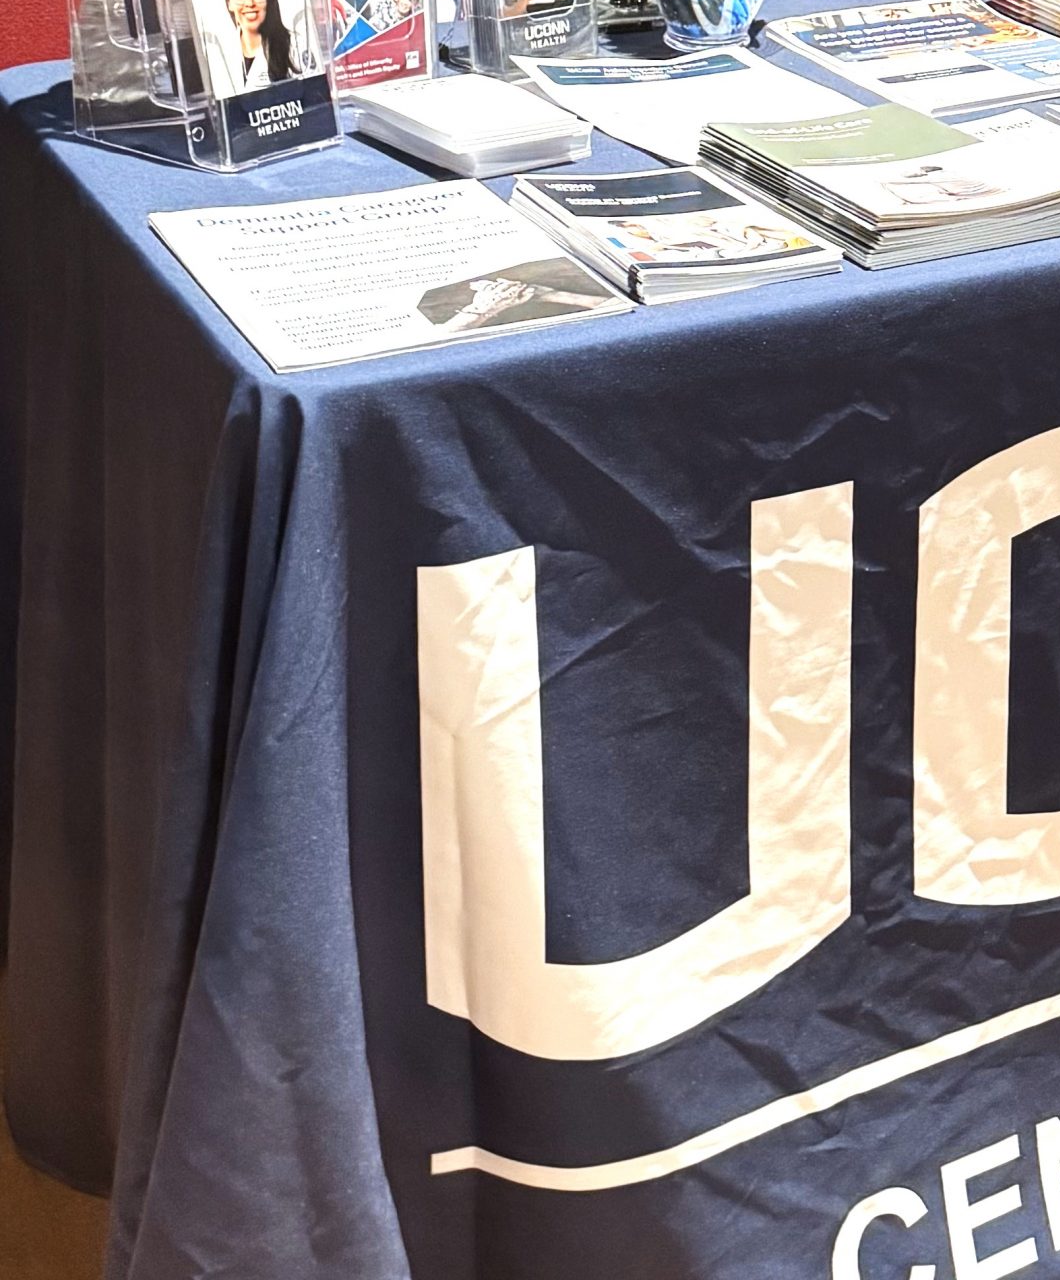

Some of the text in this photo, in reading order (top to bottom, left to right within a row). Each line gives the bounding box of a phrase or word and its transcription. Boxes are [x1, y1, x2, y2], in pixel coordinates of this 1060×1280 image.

[524, 20, 571, 40] UCONN
[531, 35, 568, 50] HEALTH
[249, 100, 303, 127] UCONN
[257, 118, 300, 137] HEALTH
[197, 189, 466, 229] Dementia Caregiver
[240, 202, 447, 237] Support Group
